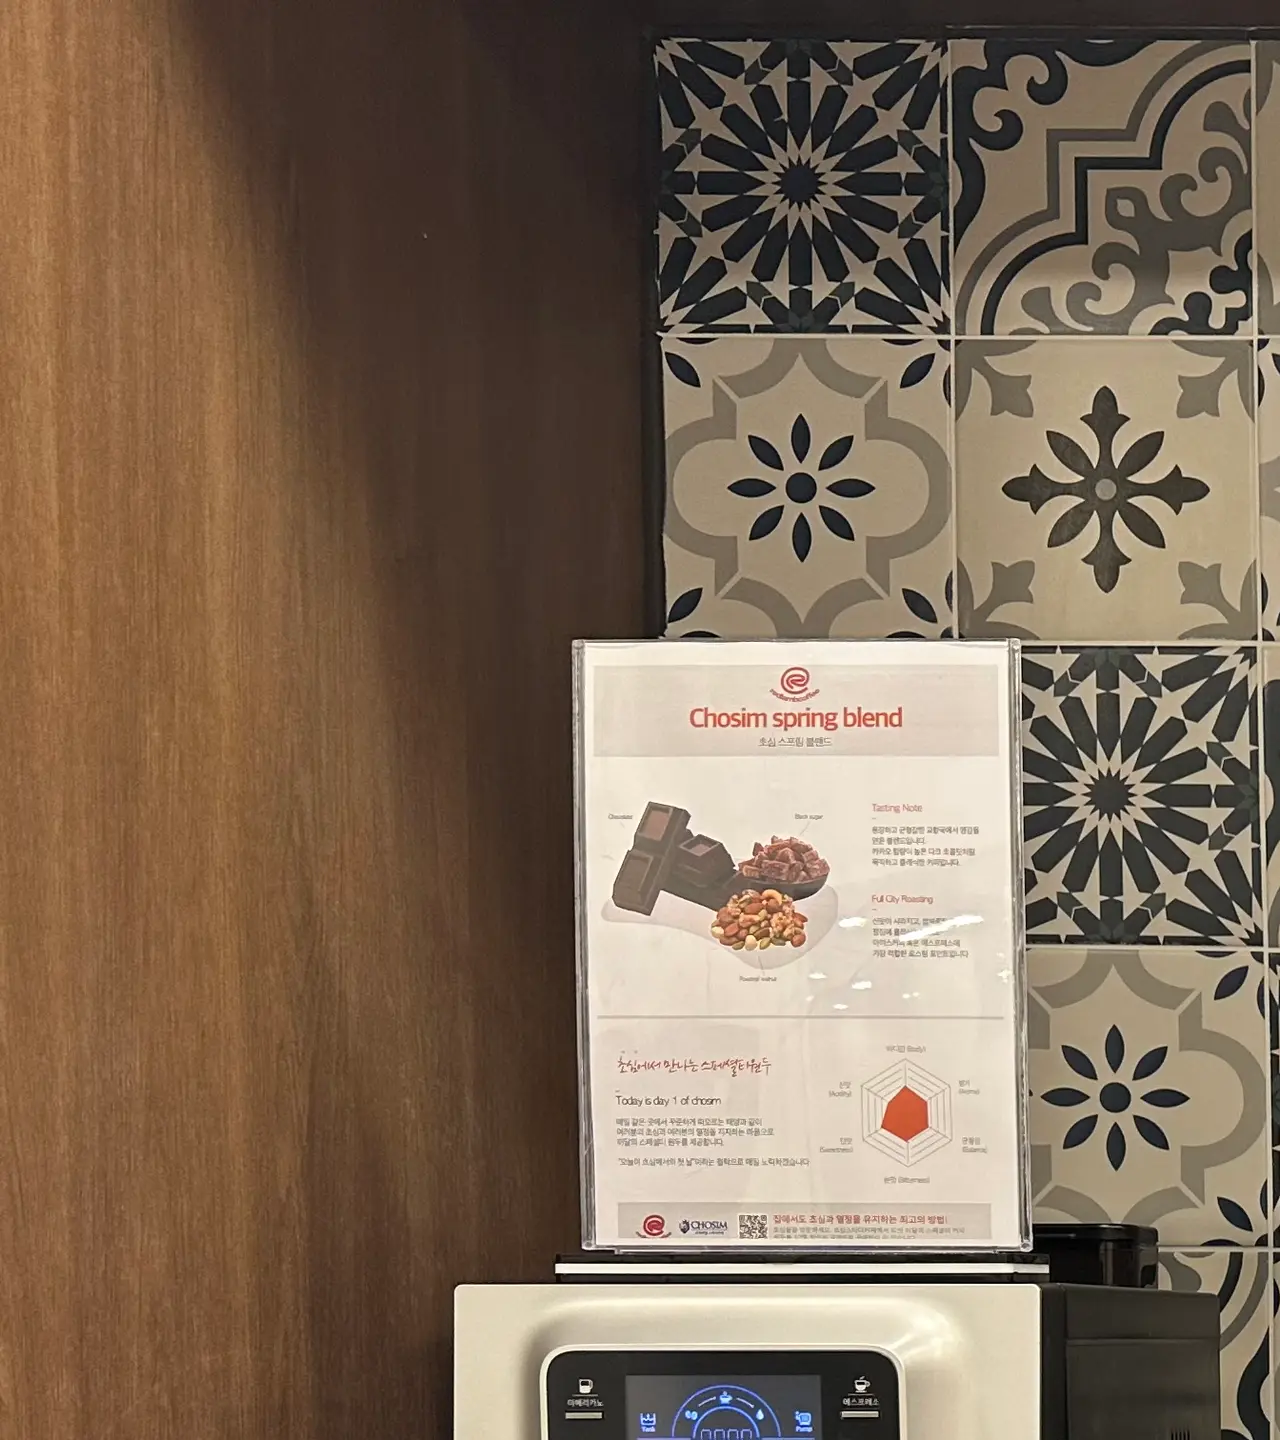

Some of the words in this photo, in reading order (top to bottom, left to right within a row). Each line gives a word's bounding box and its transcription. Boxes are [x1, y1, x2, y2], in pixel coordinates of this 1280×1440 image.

[690, 706, 767, 729] Chosim
[772, 706, 838, 731] spring
[843, 706, 903, 728] blend
[872, 803, 901, 813] Tasting
[902, 803, 922, 813] Note
[691, 1220, 728, 1230] CHOSIM
[567, 1398, 604, 1408] 아메리카노
[843, 1397, 879, 1407] 에스프레소
